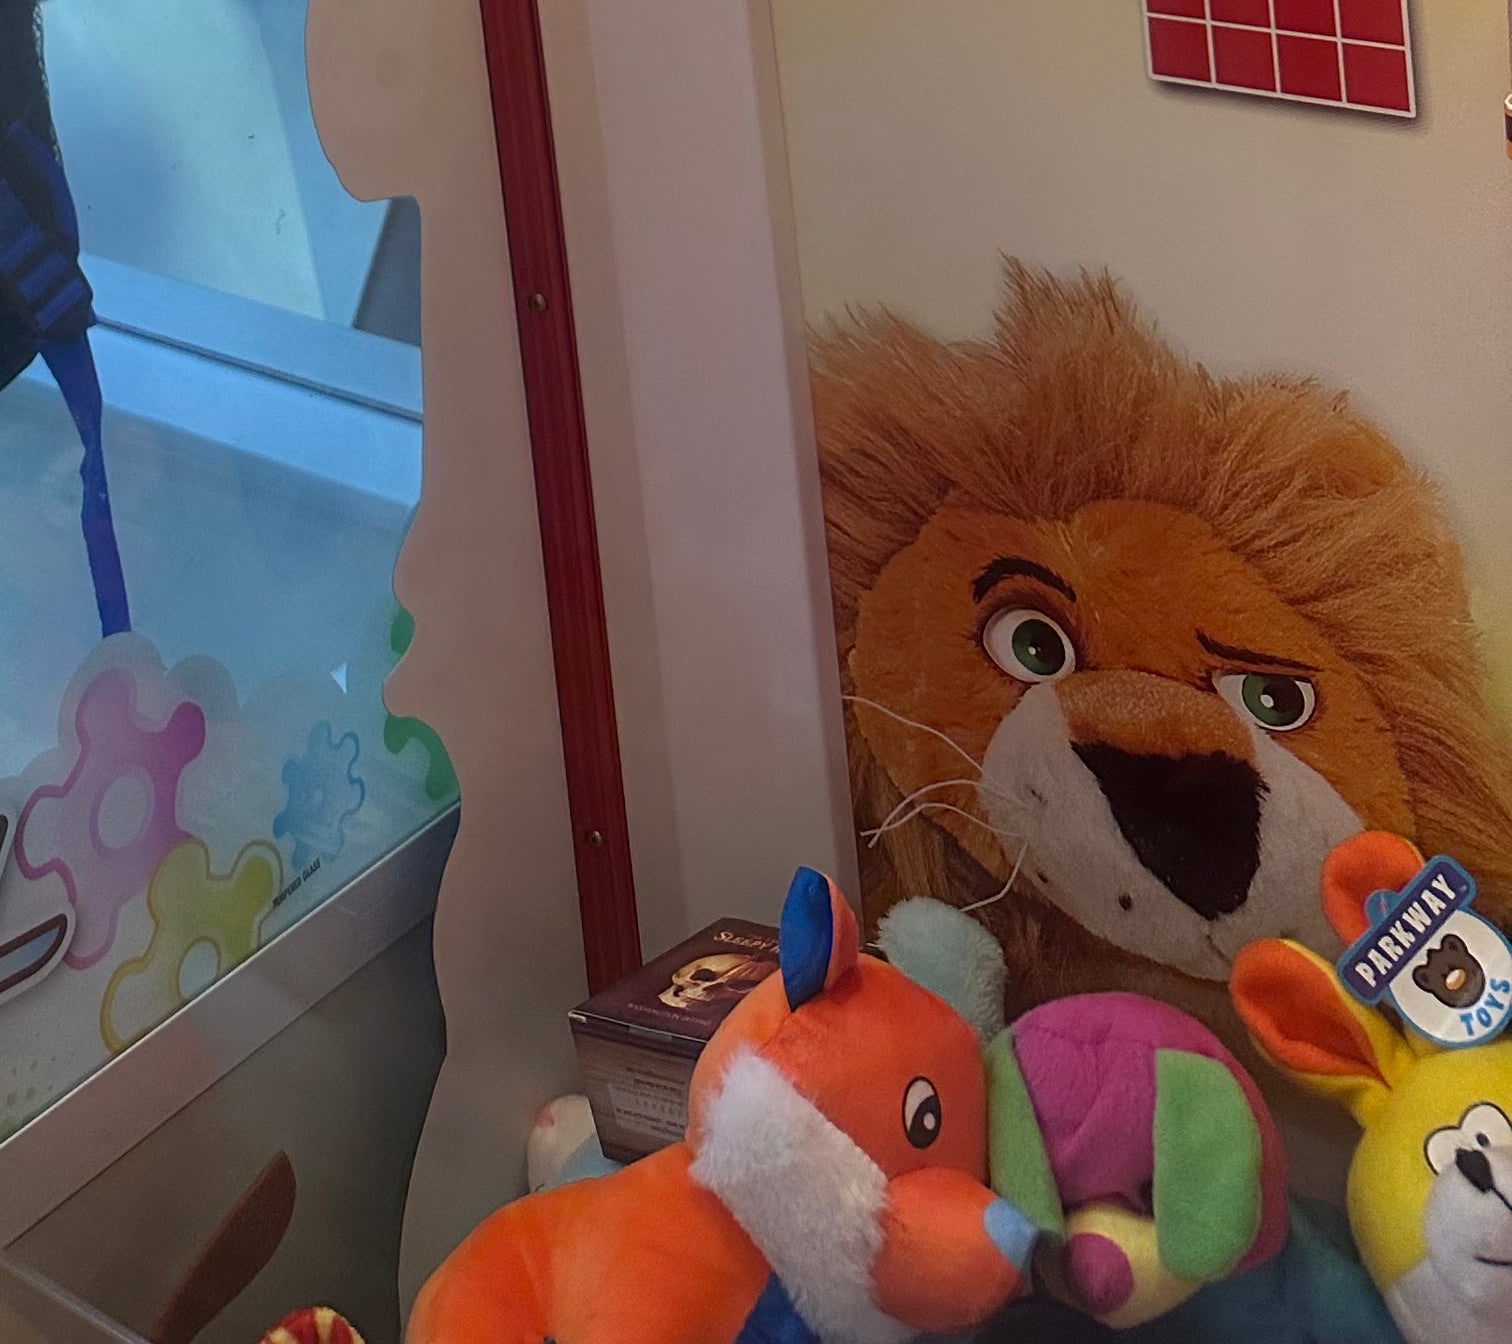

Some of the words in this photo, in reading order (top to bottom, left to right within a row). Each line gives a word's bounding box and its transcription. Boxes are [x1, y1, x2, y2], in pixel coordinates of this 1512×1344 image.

[713, 931, 772, 951] SLEEPY
[1354, 873, 1457, 988] PARKWAY
[1459, 977, 1512, 1037] TOYS
